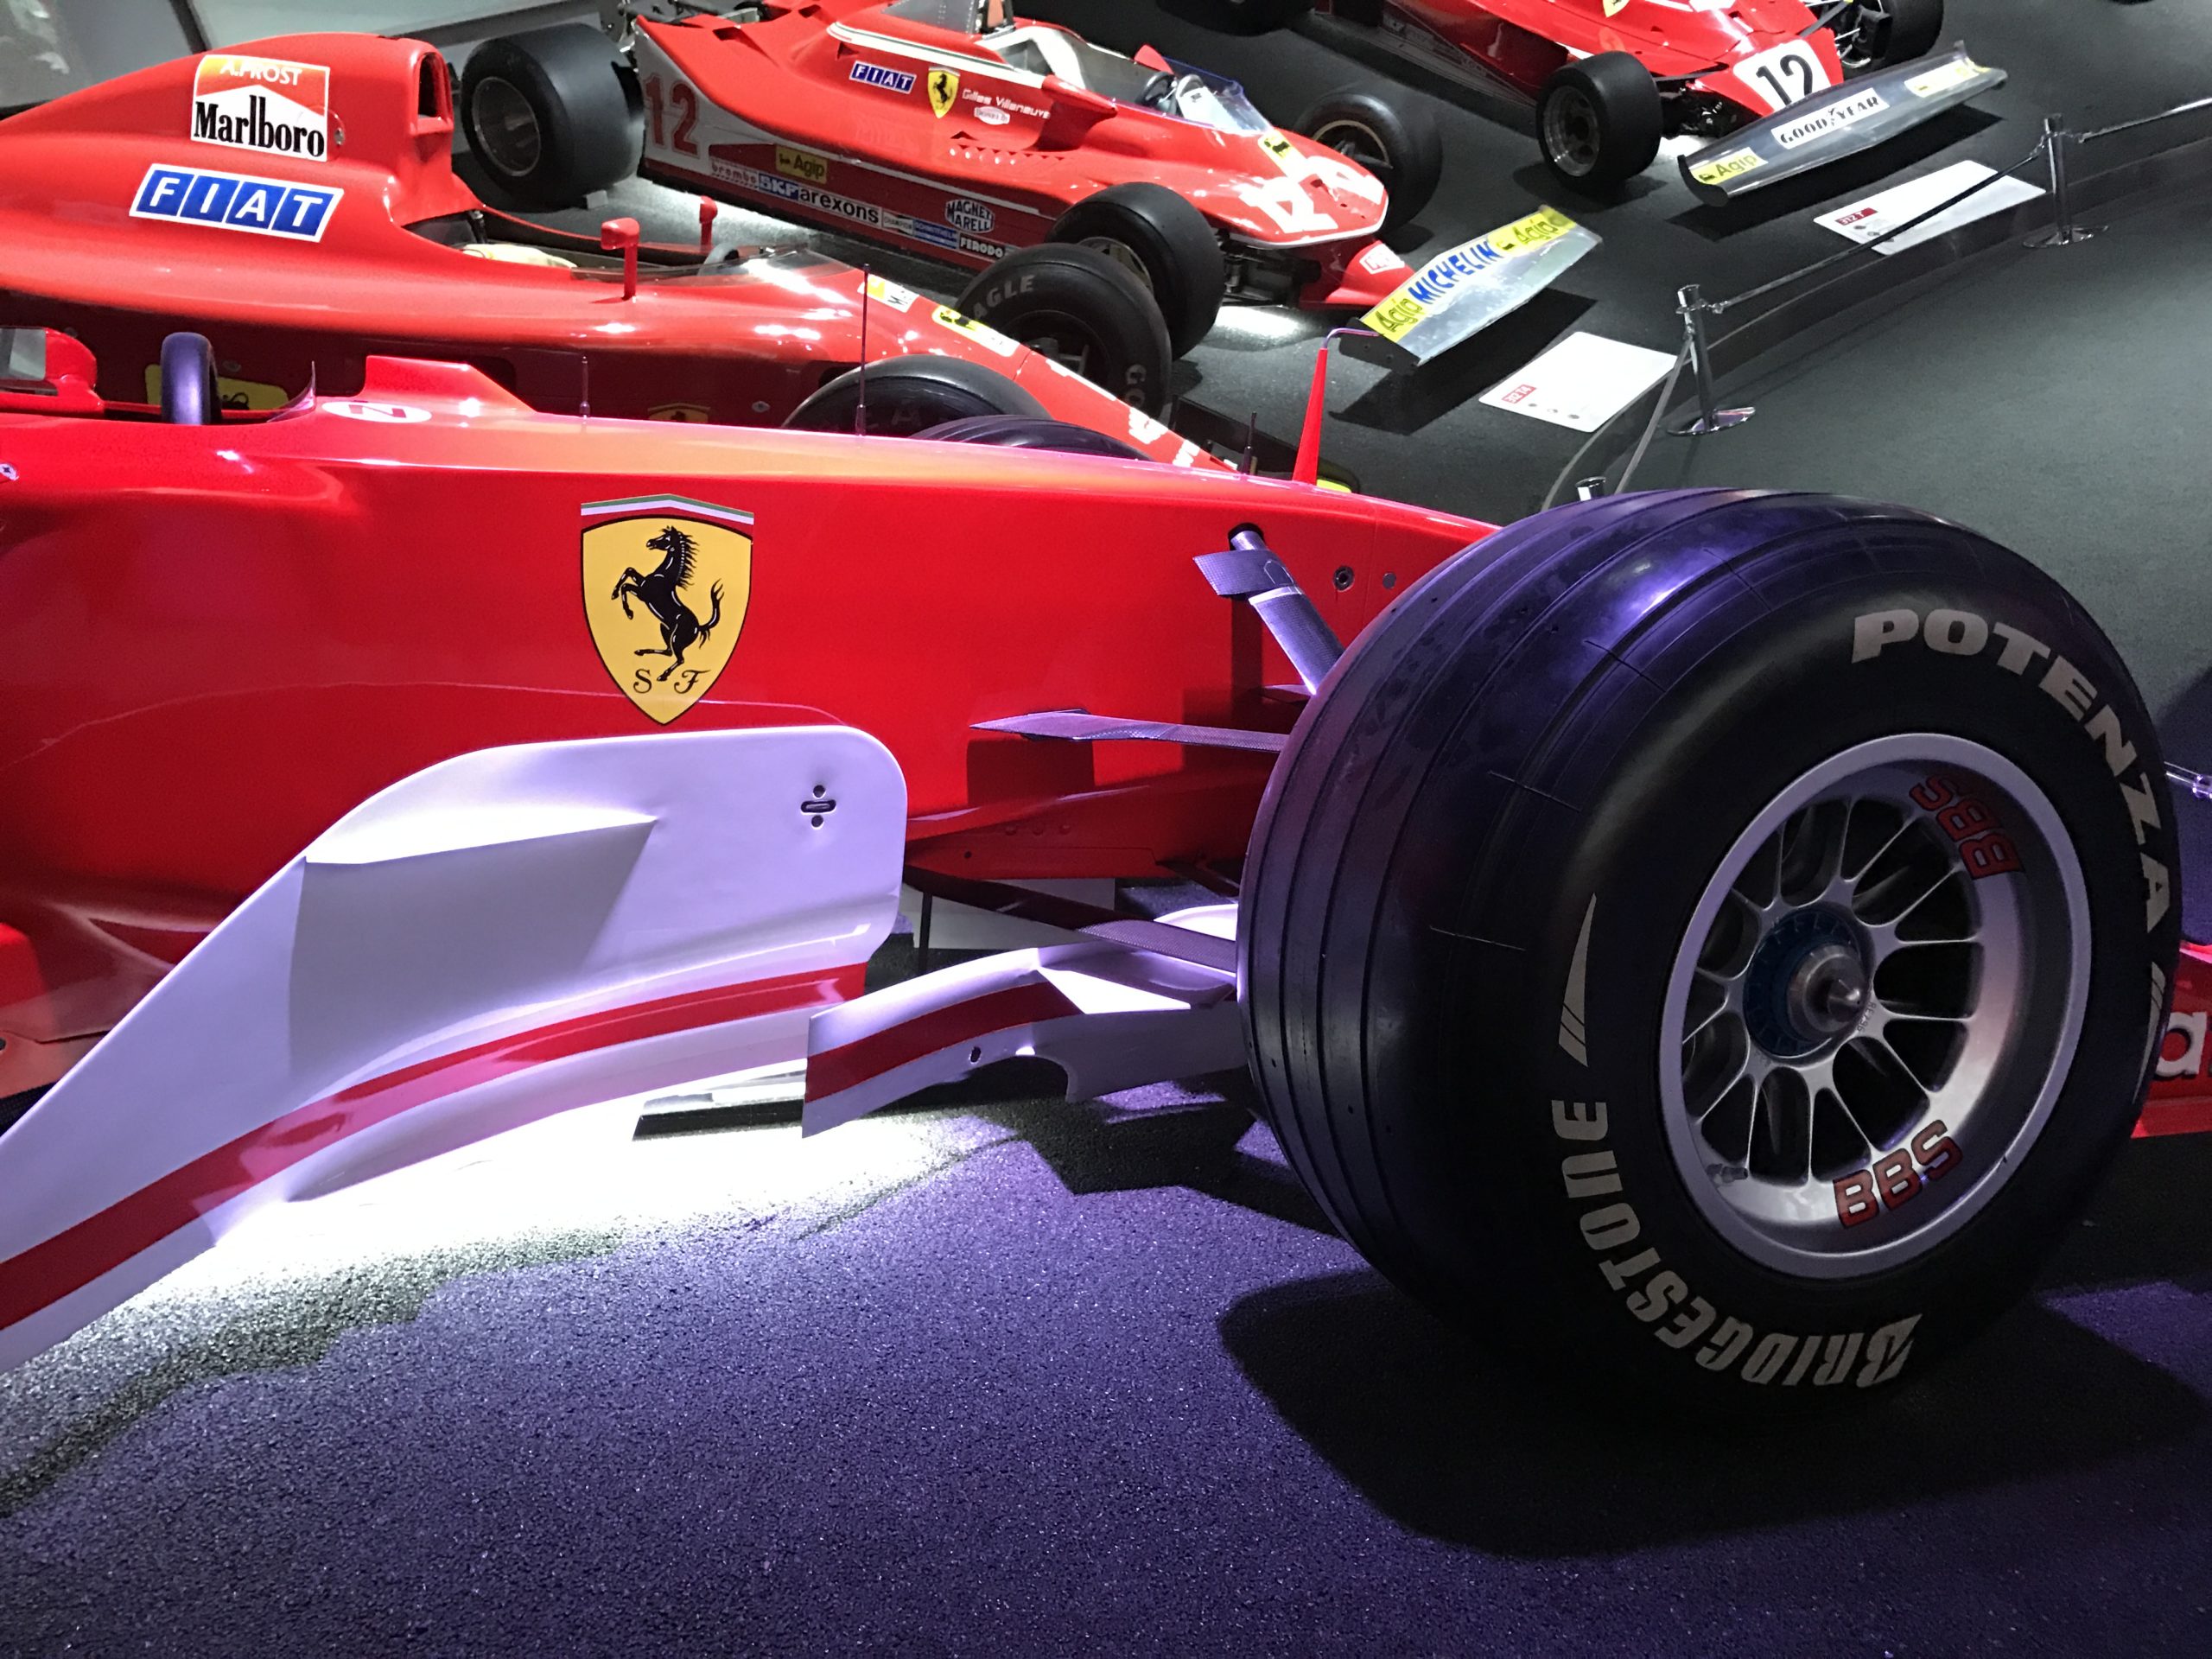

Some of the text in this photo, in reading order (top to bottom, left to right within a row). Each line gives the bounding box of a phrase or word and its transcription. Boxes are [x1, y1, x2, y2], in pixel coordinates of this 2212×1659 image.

[219, 57, 303, 86] A.PROST
[855, 65, 913, 90] FIAT
[1756, 54, 1814, 105] 12
[962, 88, 992, 105] Gilles
[193, 94, 326, 158] Marlboro
[644, 73, 701, 159] 12
[1780, 95, 1879, 144] GOODYEAR
[793, 154, 825, 179] Agip
[1714, 153, 1758, 178] Agip
[148, 175, 324, 229] FIAT
[760, 175, 798, 198] SKF
[800, 187, 880, 224] arexons
[1839, 213, 1858, 225] 312
[960, 237, 1004, 258] FERODO
[1512, 218, 1559, 246] Agip
[1408, 240, 1505, 305] MICHELIN
[970, 273, 1036, 321] AGLE
[1375, 296, 1428, 333] Agip
[632, 668, 711, 694] S F
[1851, 607, 2171, 934] POTENZA
[1908, 773, 2025, 880] BBS
[1832, 1118, 1963, 1229] BBS
[1551, 1098, 1923, 1389] BRIDGESTONE
